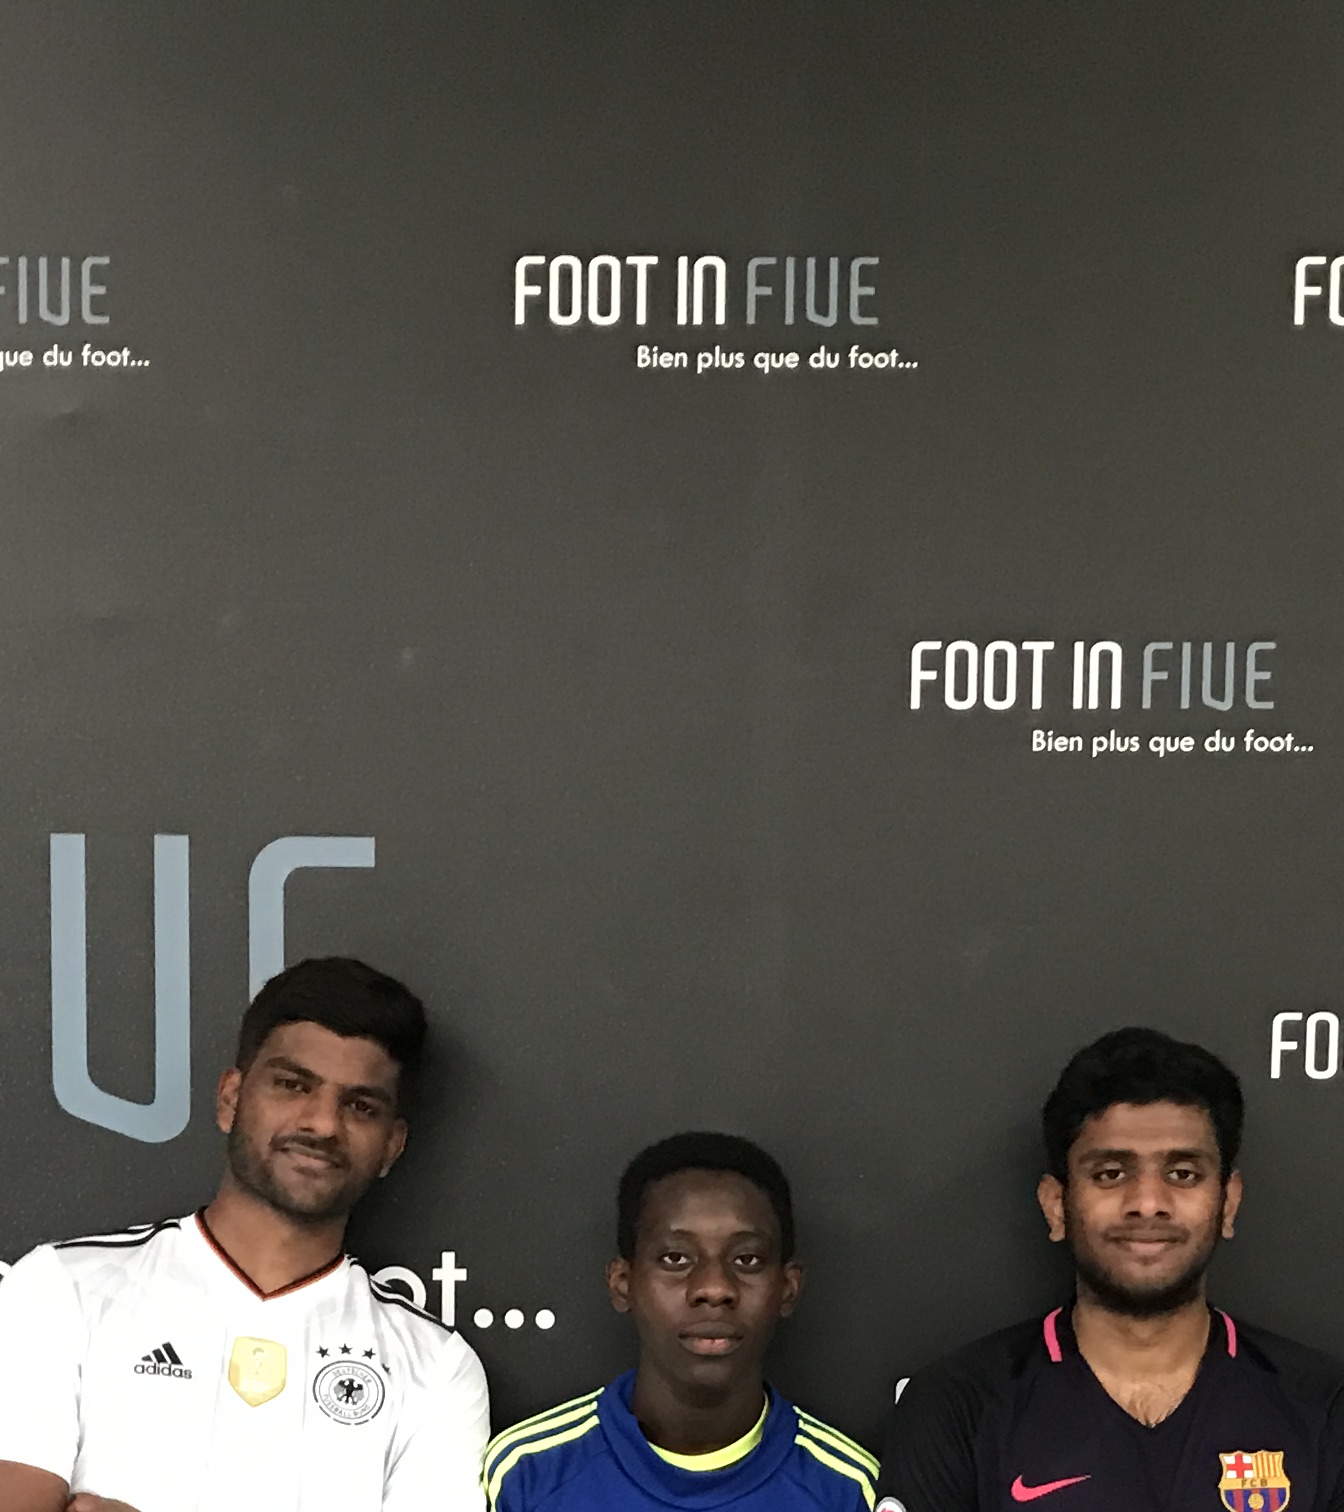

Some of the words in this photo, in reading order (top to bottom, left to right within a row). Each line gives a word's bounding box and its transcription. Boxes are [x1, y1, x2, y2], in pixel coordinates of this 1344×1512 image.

[515, 254, 659, 327] FOOT
[676, 255, 727, 326] IN
[746, 256, 880, 328] FIVE
[42, 344, 72, 367] du
[81, 344, 151, 368] foot...
[636, 345, 688, 369] Bien
[697, 345, 745, 374] plus
[754, 352, 800, 374] que
[809, 345, 840, 369] du
[848, 345, 919, 370] foot...
[909, 640, 1055, 711] FOOT
[1072, 640, 1123, 711] IN
[1141, 641, 1277, 712] FIVE
[1031, 730, 1083, 753] Bien
[1092, 730, 1140, 758] plus
[1148, 735, 1195, 758] que
[1204, 730, 1235, 753] du
[1243, 729, 1315, 754] foot...
[134, 1361, 193, 1380] adidas
